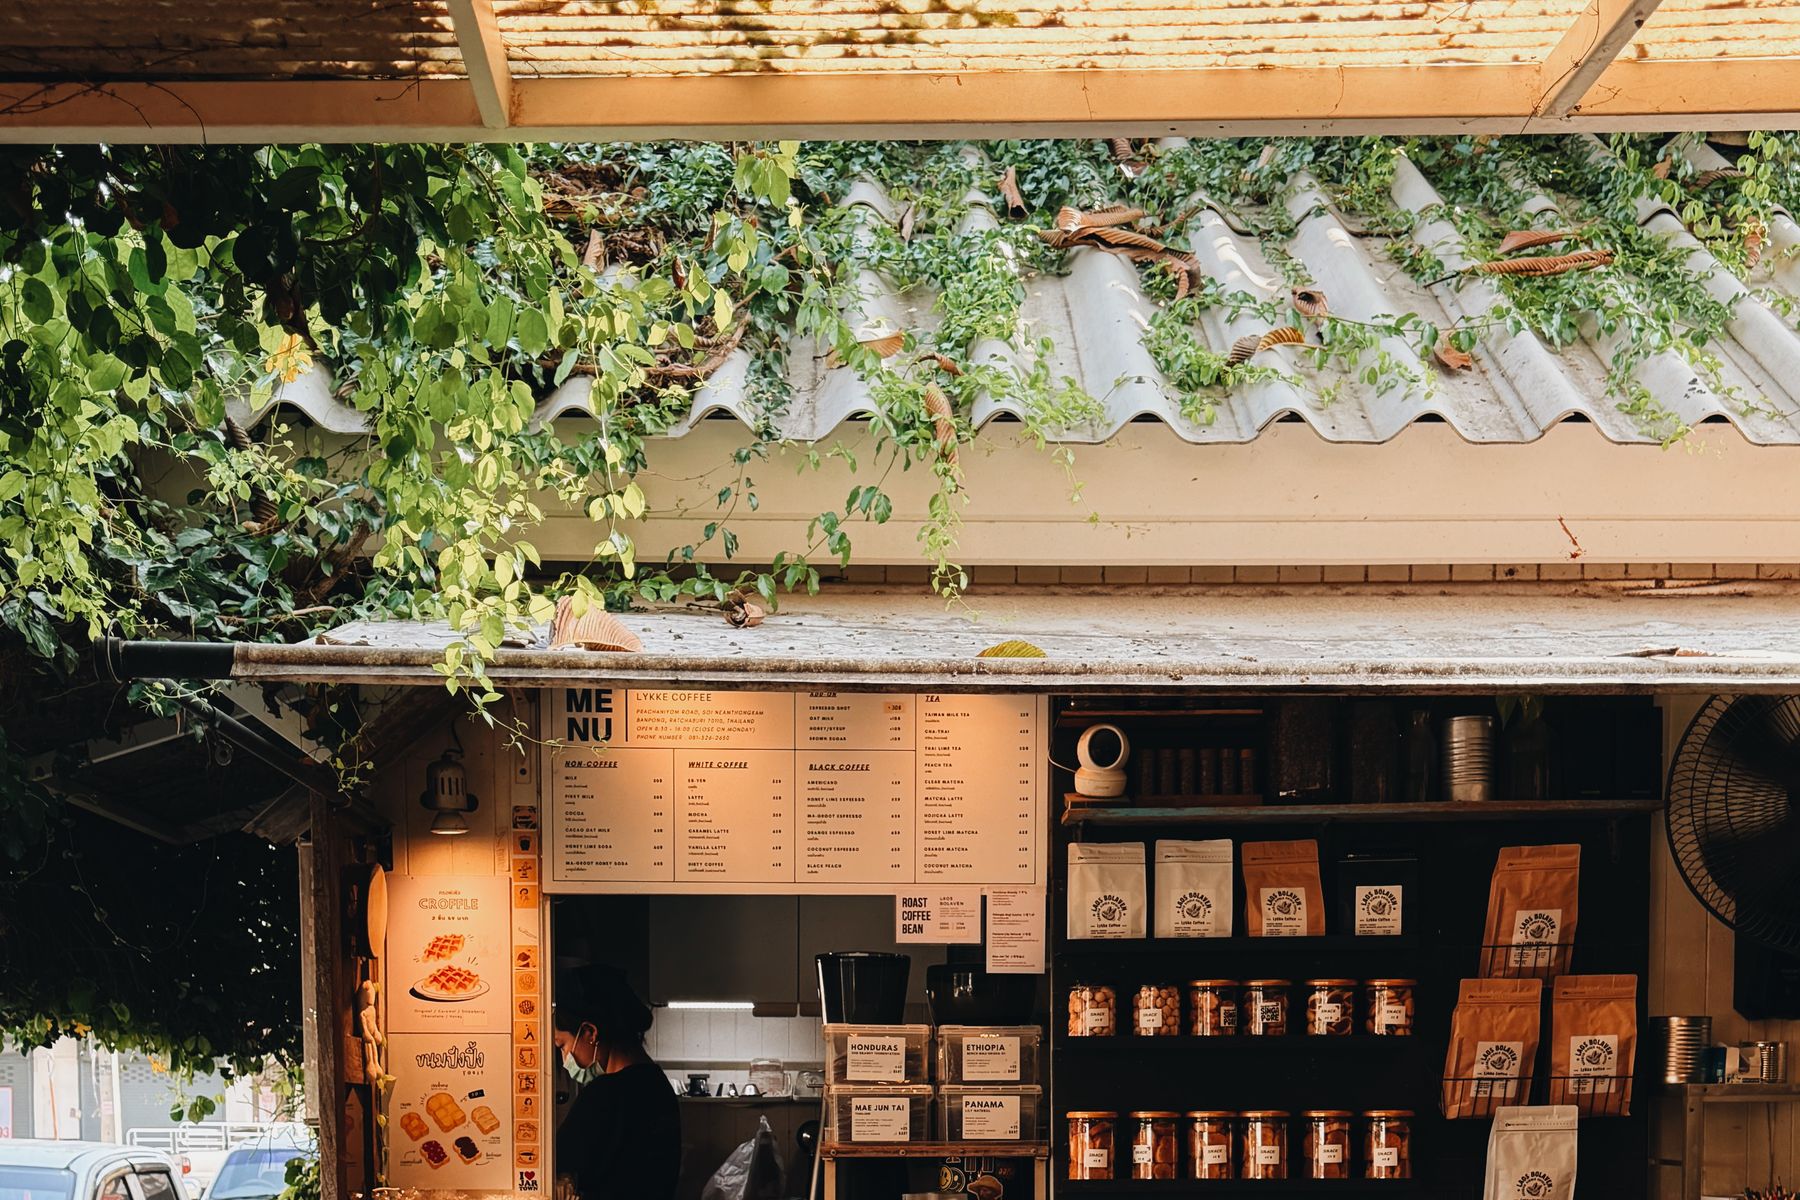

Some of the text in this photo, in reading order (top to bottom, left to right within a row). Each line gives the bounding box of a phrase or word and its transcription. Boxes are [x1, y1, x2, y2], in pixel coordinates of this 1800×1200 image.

[565, 688, 613, 713] ME
[636, 692, 712, 702] LYKKE COFFEE
[925, 694, 941, 703] TEA
[566, 716, 612, 743] NU
[564, 760, 618, 769] NON-COFFEE
[716, 761, 748, 769] COFFEE
[808, 763, 871, 772] BLACK COFFEE
[418, 898, 479, 910] CROFFLE
[902, 897, 928, 908] ROAST
[1091, 894, 1128, 912] LAOS BOLAVEN
[1176, 892, 1212, 909] LAOS BOLAVEN
[1266, 890, 1302, 906] LAOS BOLAVEN
[1362, 889, 1398, 906] LAOS BOLAVEN
[902, 910, 931, 921] COFFEE
[1519, 913, 1556, 930] LAOS BOLAVEN
[902, 924, 924, 934] BEAN
[1260, 1007, 1279, 1015] SINGA
[1480, 1045, 1517, 1061] LAOS BOLAVEN
[1575, 1038, 1613, 1057] LAOS BOLAVEN
[415, 1041, 484, 1070] ขนมปังปิ้ง
[519, 1172, 524, 1180] I
[1516, 1171, 1553, 1188] LAOS BOLAVEN
